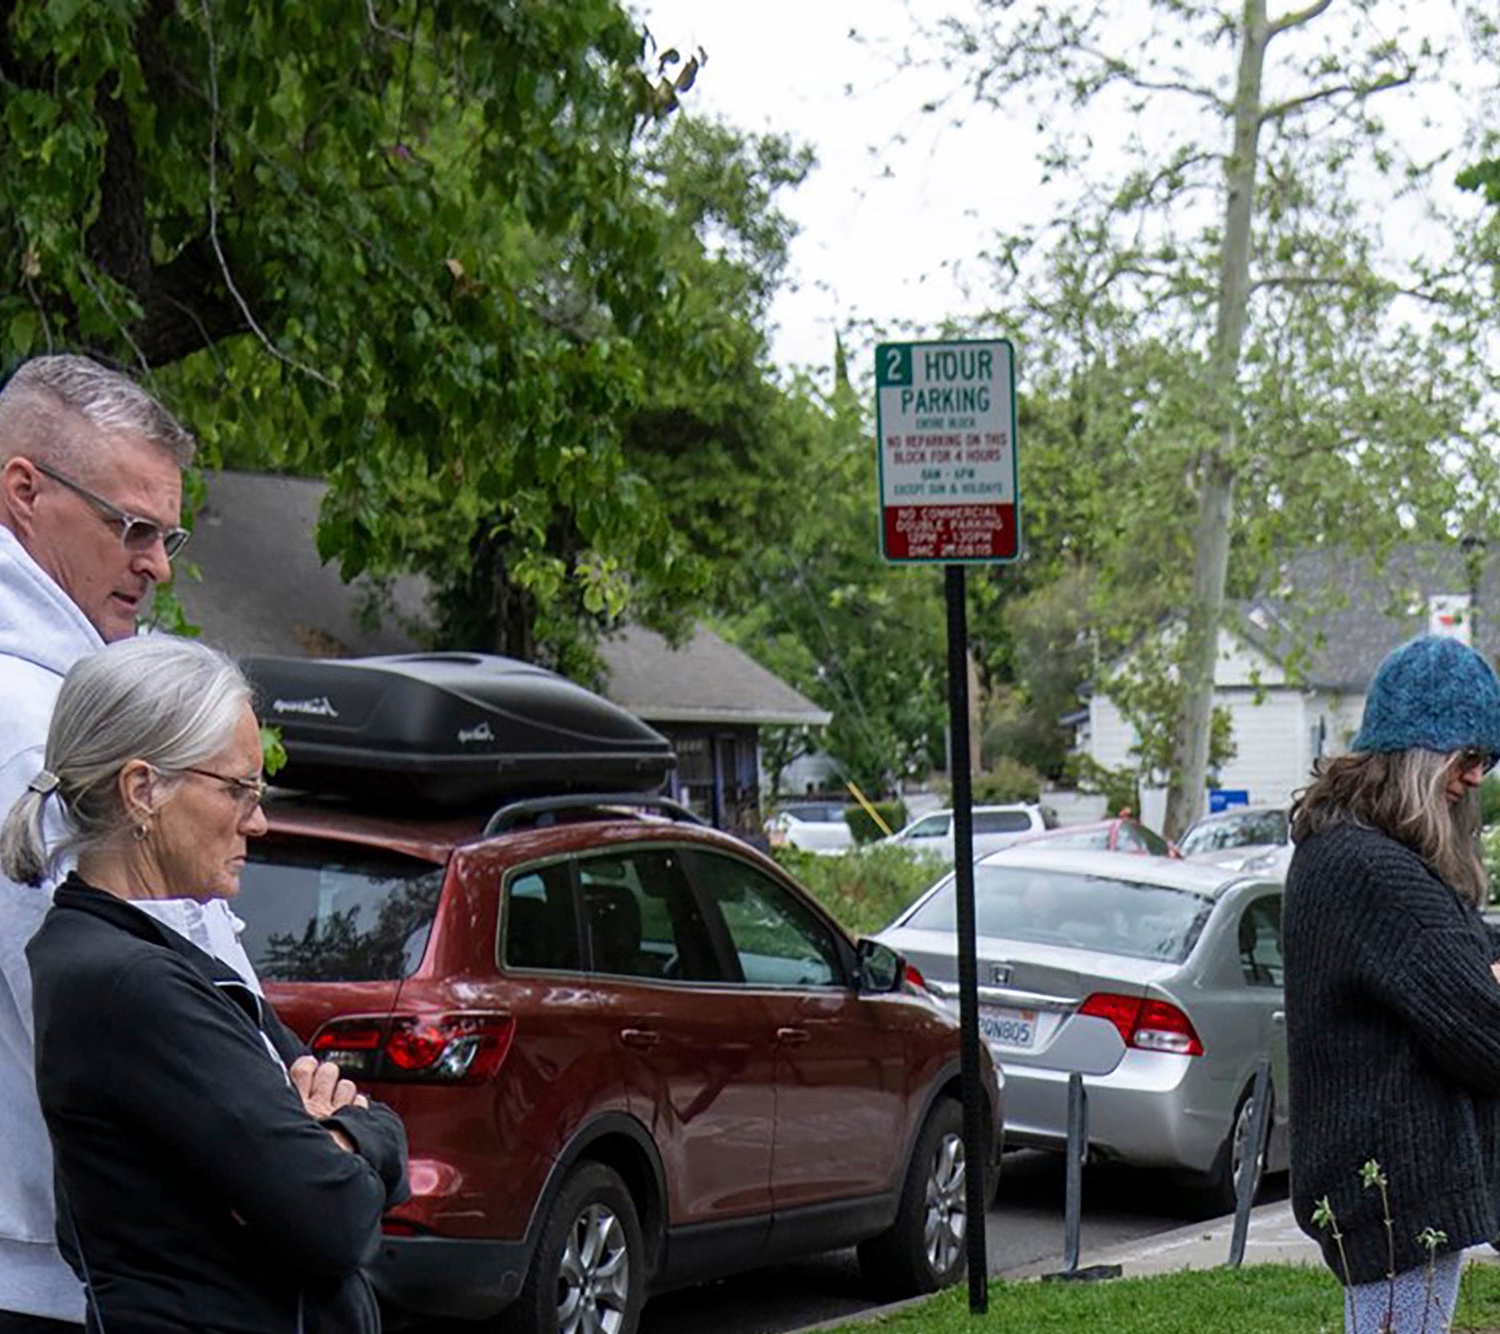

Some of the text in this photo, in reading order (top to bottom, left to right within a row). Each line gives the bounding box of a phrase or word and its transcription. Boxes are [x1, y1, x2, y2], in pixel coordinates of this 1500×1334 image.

[887, 351, 993, 381] 2 HOUR
[901, 387, 990, 414] PARKING
[887, 436, 901, 447] NO
[894, 452, 925, 464] BLOCK
[931, 452, 951, 463] FOR
[966, 451, 1001, 462] HOURS
